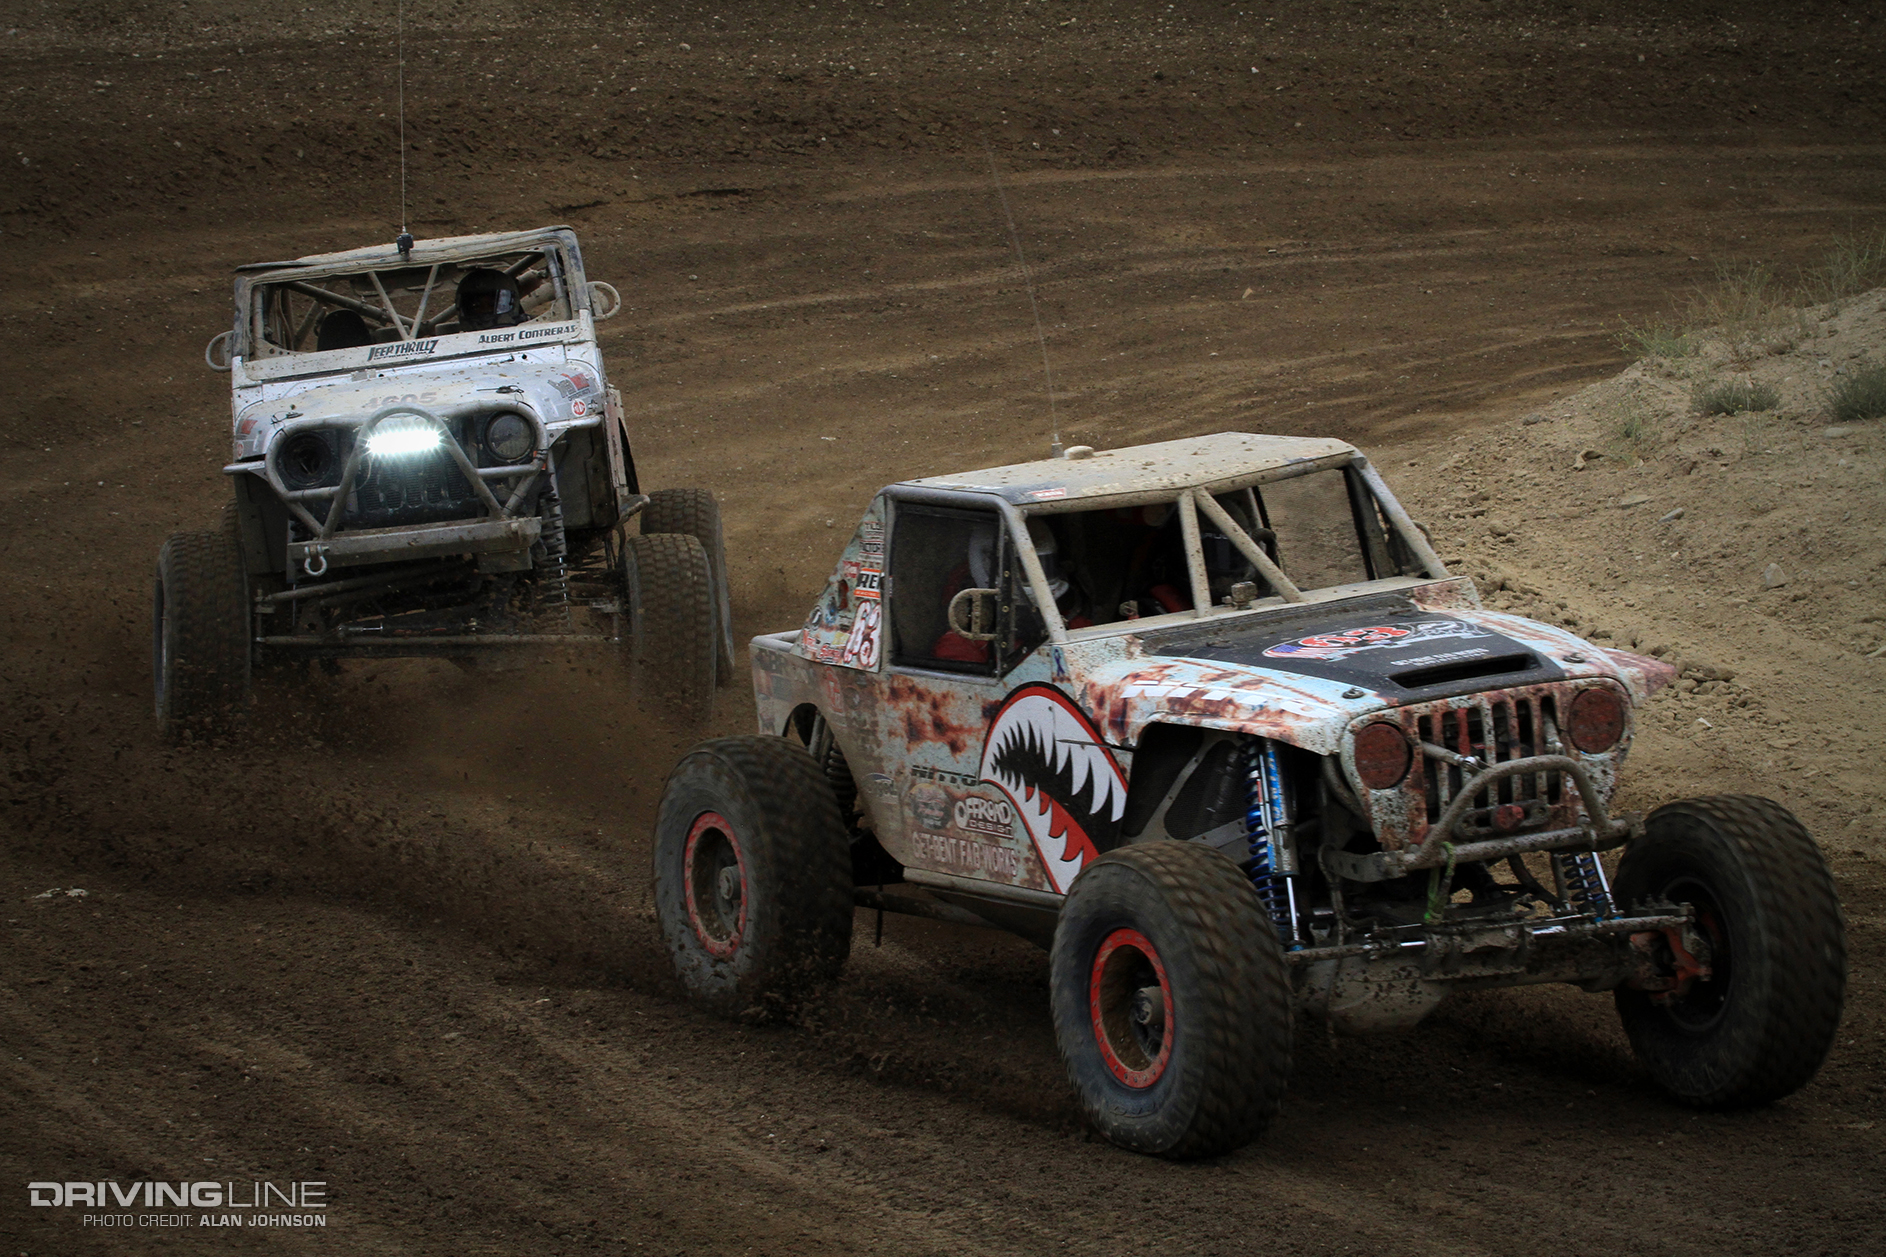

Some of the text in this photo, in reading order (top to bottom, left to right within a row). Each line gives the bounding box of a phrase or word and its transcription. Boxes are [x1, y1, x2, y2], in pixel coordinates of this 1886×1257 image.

[478, 325, 576, 343] ALBERT CONTRERAS
[1120, 680, 1341, 719] NITTO
[911, 764, 977, 787] NITTO
[954, 796, 1012, 829] OFFROAD
[959, 840, 980, 870] FAB
[982, 843, 1017, 877] WORKS
